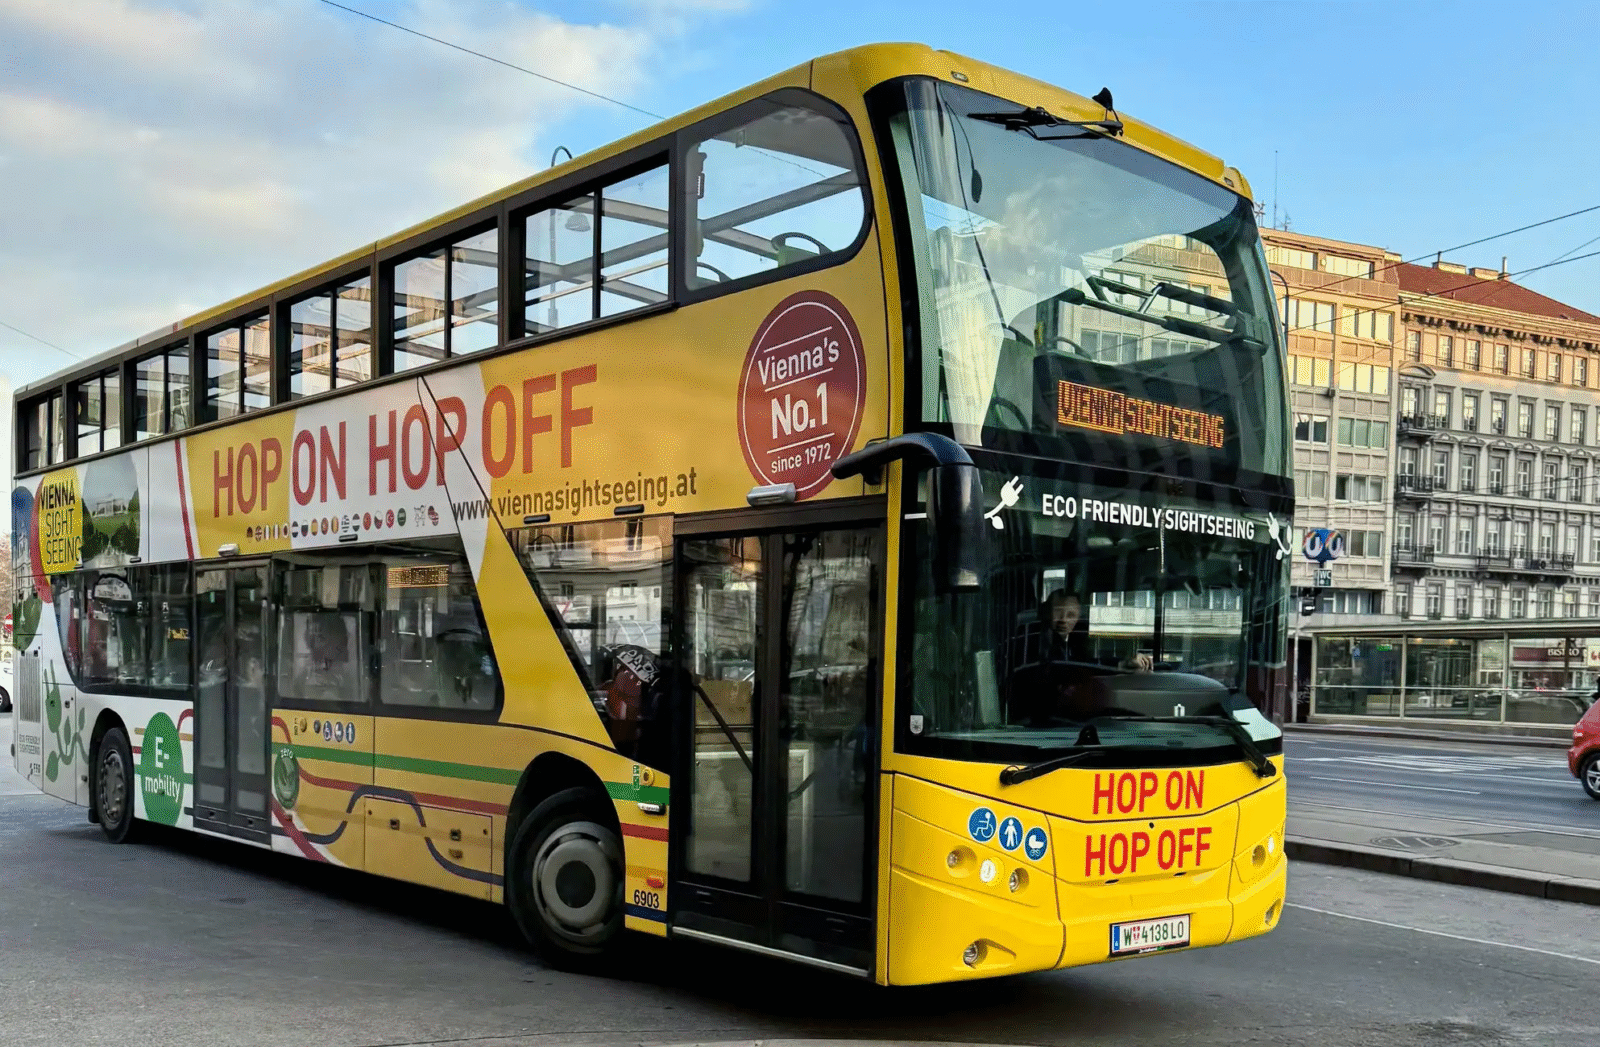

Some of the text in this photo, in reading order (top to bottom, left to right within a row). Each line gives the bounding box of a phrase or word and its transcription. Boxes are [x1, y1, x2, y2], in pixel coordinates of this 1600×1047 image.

[758, 337, 840, 386] Vienna's
[771, 382, 828, 440] No.1
[213, 363, 598, 518] HOP ON HOP OFF
[771, 442, 831, 474] since 1972
[40, 479, 76, 510] VIENNA
[453, 466, 697, 521] www.viennasightseeing.at
[45, 508, 75, 538] SIGHT
[1042, 493, 1255, 540] ECO FRIENDLY SIGHTSEEING
[46, 535, 82, 565] SEEING
[155, 736, 169, 768] E-
[145, 773, 181, 803] mobility
[1093, 770, 1204, 814] HOP ON
[1085, 827, 1212, 877] HOP OFF
[633, 889, 660, 909] 6903
